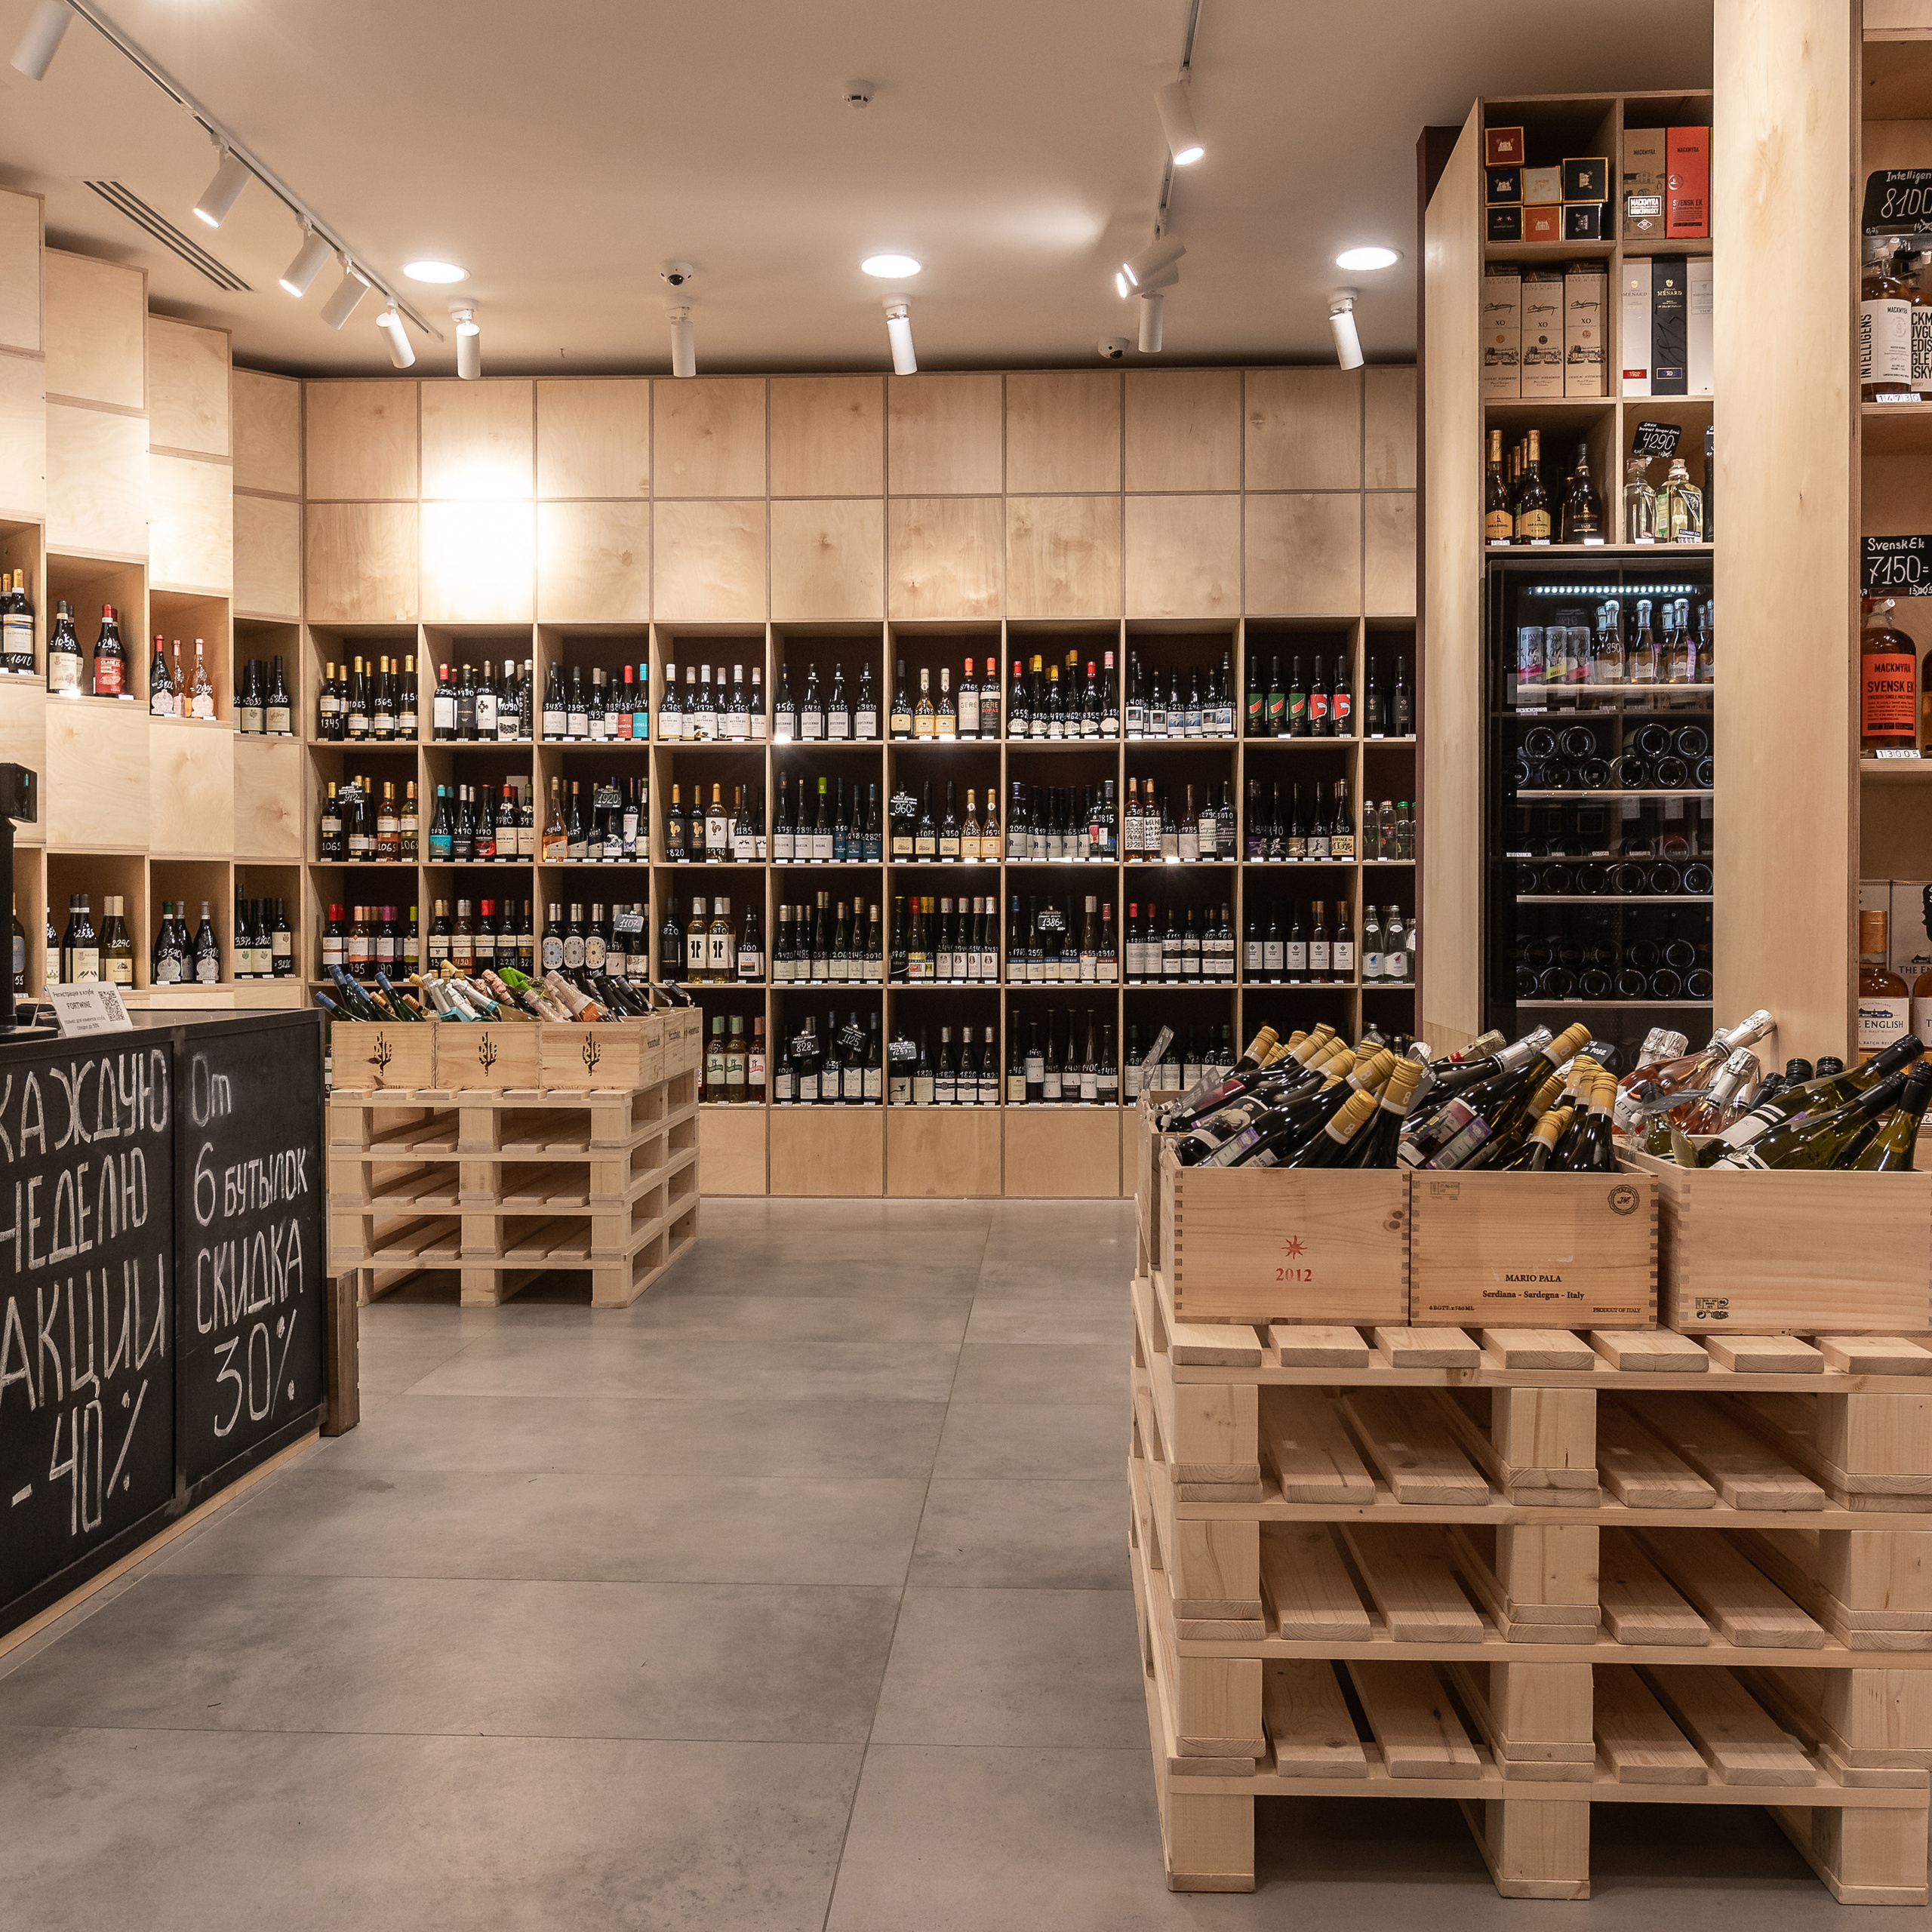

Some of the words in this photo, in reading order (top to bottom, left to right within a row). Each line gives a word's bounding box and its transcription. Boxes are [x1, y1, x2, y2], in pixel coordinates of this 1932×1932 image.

[1875, 663, 1911, 672] MACKMYRA
[1867, 681, 1905, 692] SVENSK
[1907, 681, 1914, 692] EK
[982, 700, 998, 709] GERE
[321, 718, 340, 729] 1345
[322, 841, 340, 851] 1065
[66, 1001, 92, 1010] FORTWINE
[0, 1050, 168, 1163] КАЖДУЮ
[193, 1143, 217, 1226] 6
[223, 1146, 308, 1217] БУТЫЛОК
[0, 1147, 147, 1273] НЕДЕЛЮ
[196, 1218, 303, 1334] СКИДКА
[1275, 1268, 1312, 1282] 2012
[1506, 1274, 1537, 1282] MARIO
[1482, 1290, 1516, 1298] Serdiana
[1524, 1291, 1559, 1300] Sardegna
[1567, 1291, 1585, 1300] Italy
[0, 1254, 165, 1411] АКЦИИ
[214, 1309, 297, 1437] 30%
